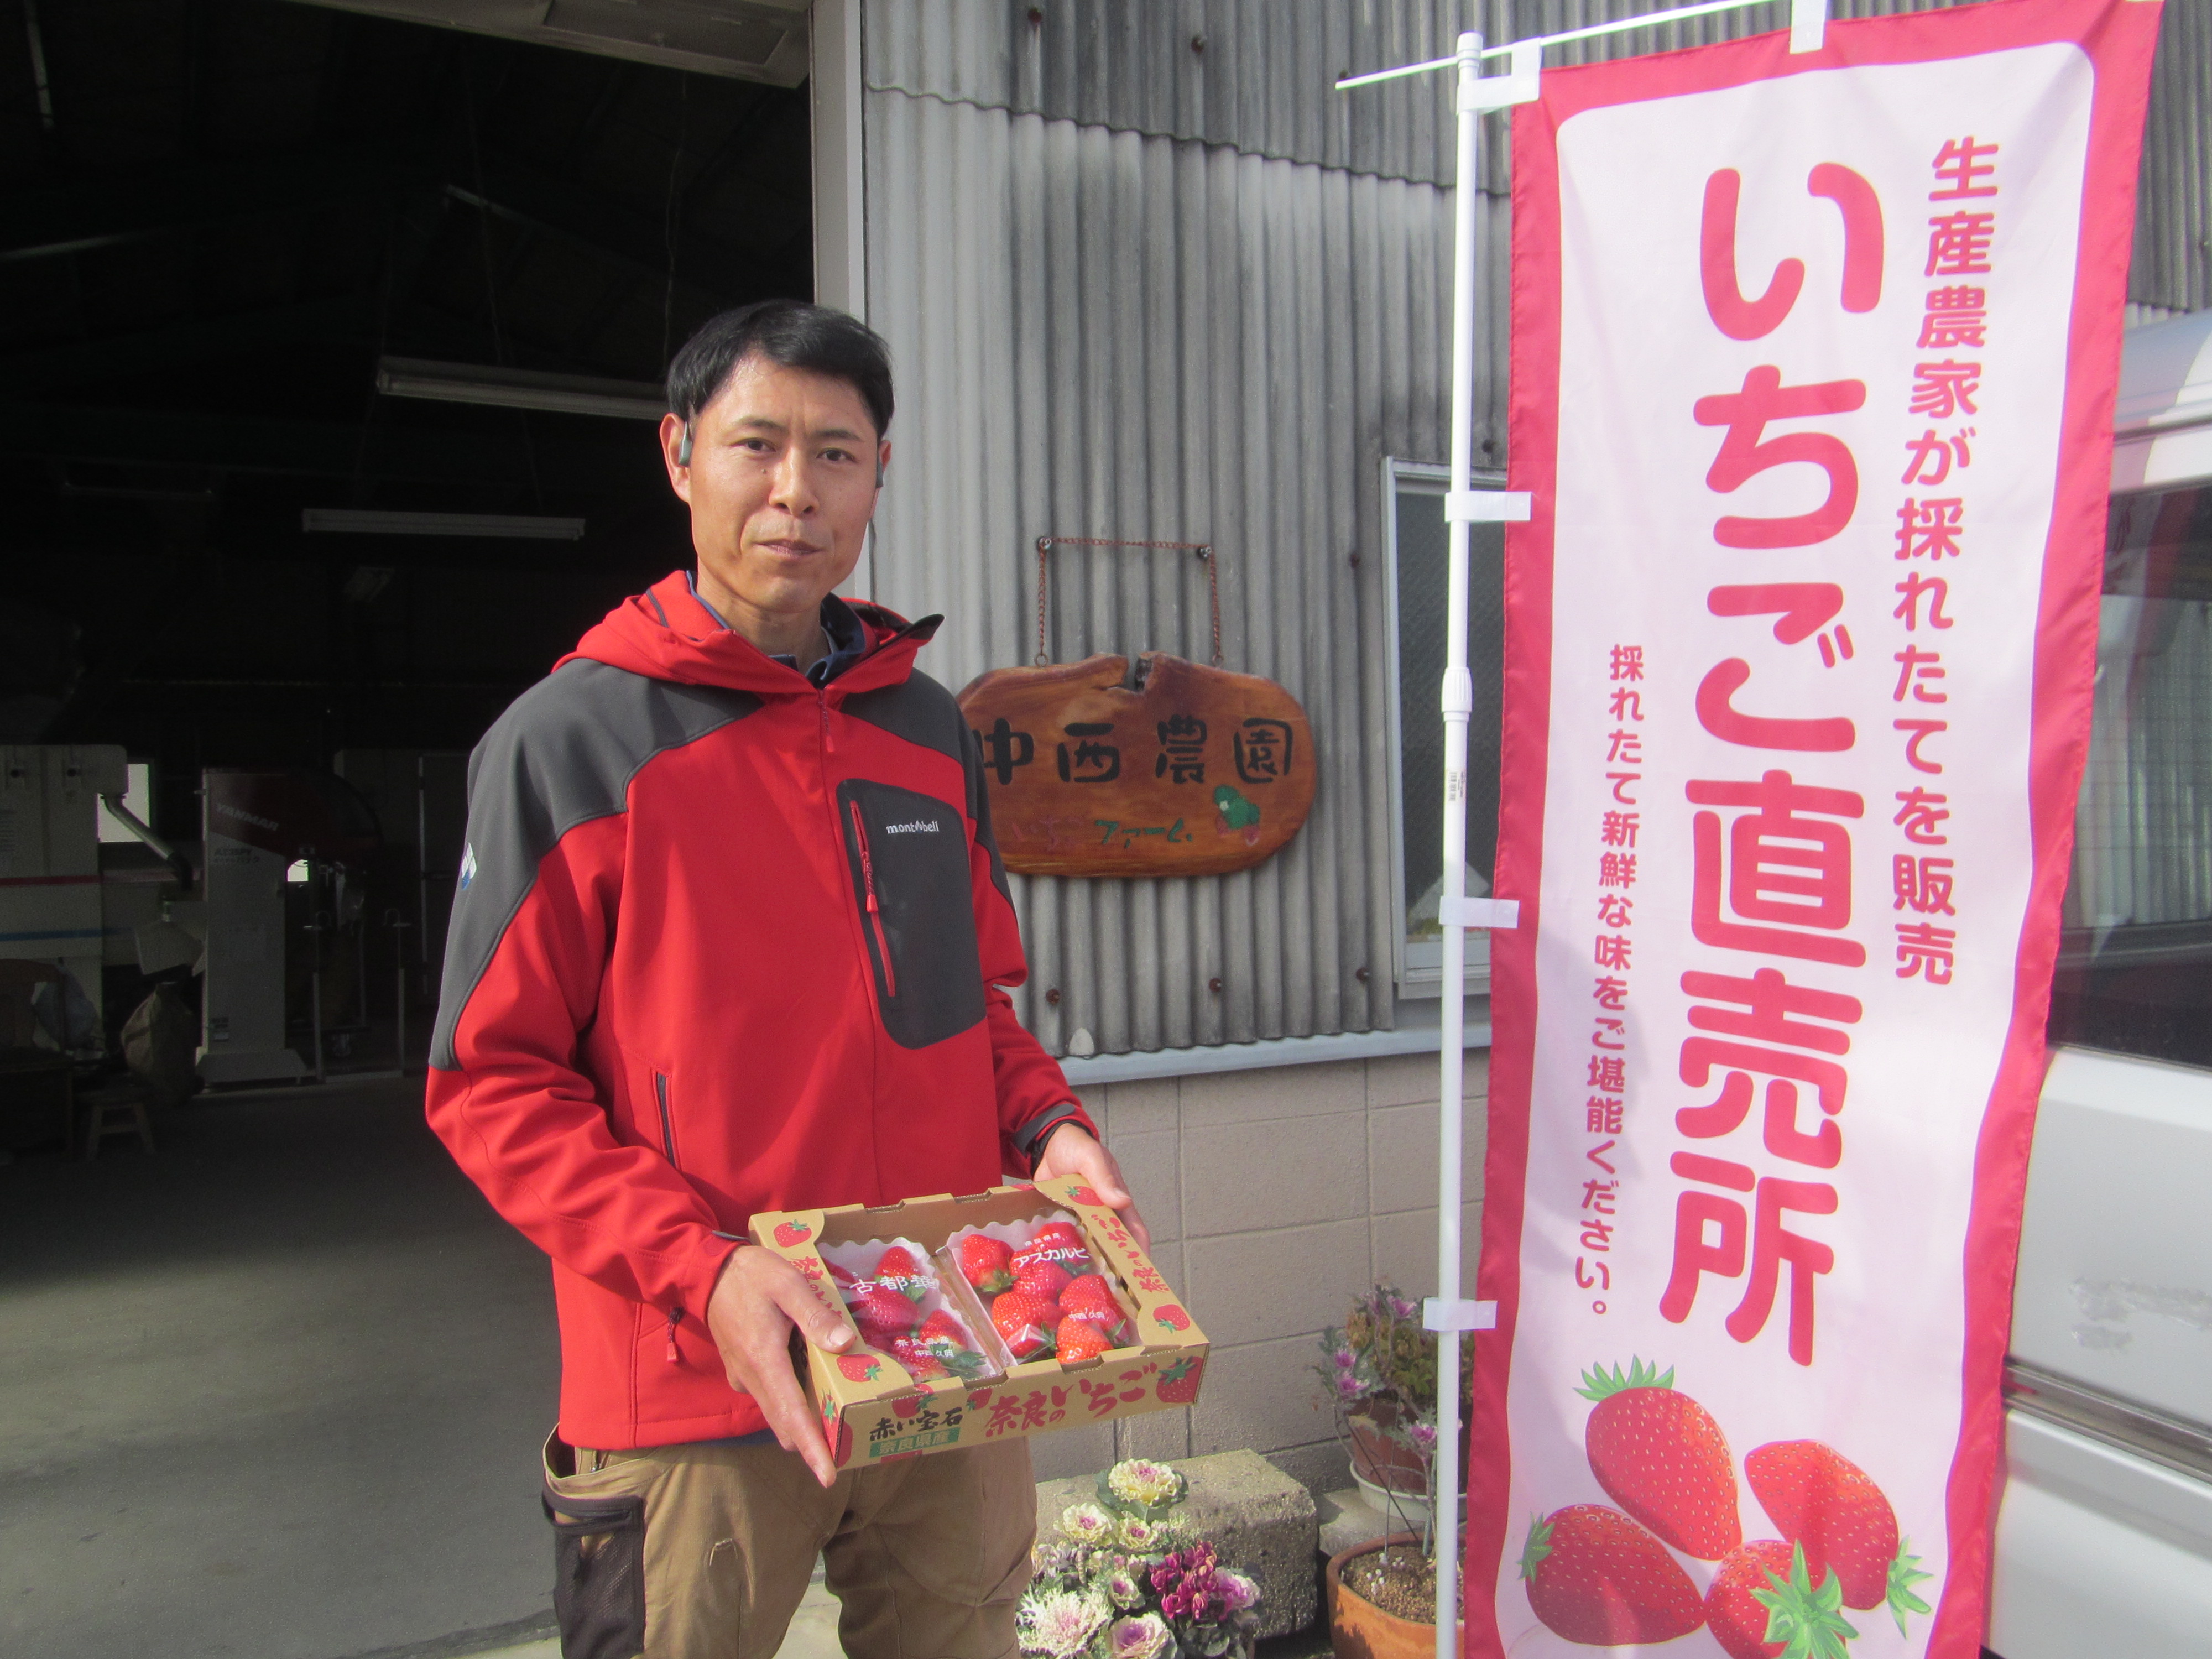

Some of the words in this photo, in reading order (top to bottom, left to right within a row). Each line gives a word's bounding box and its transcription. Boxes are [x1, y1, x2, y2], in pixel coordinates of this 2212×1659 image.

[1892, 136, 1999, 985] 生産農家が採れたてを販売
[1659, 161, 1884, 1367] いちご直売所
[216, 802, 279, 832] YANMAR
[1575, 644, 1644, 1315] 採れたて新鮮な味をご堪能ください。
[849, 1274, 937, 1294] 古都華
[869, 1406, 963, 1441] 赤い宝石
[985, 1361, 1157, 1438] 奈良のいちご
[879, 1431, 950, 1455] 奈良県産
